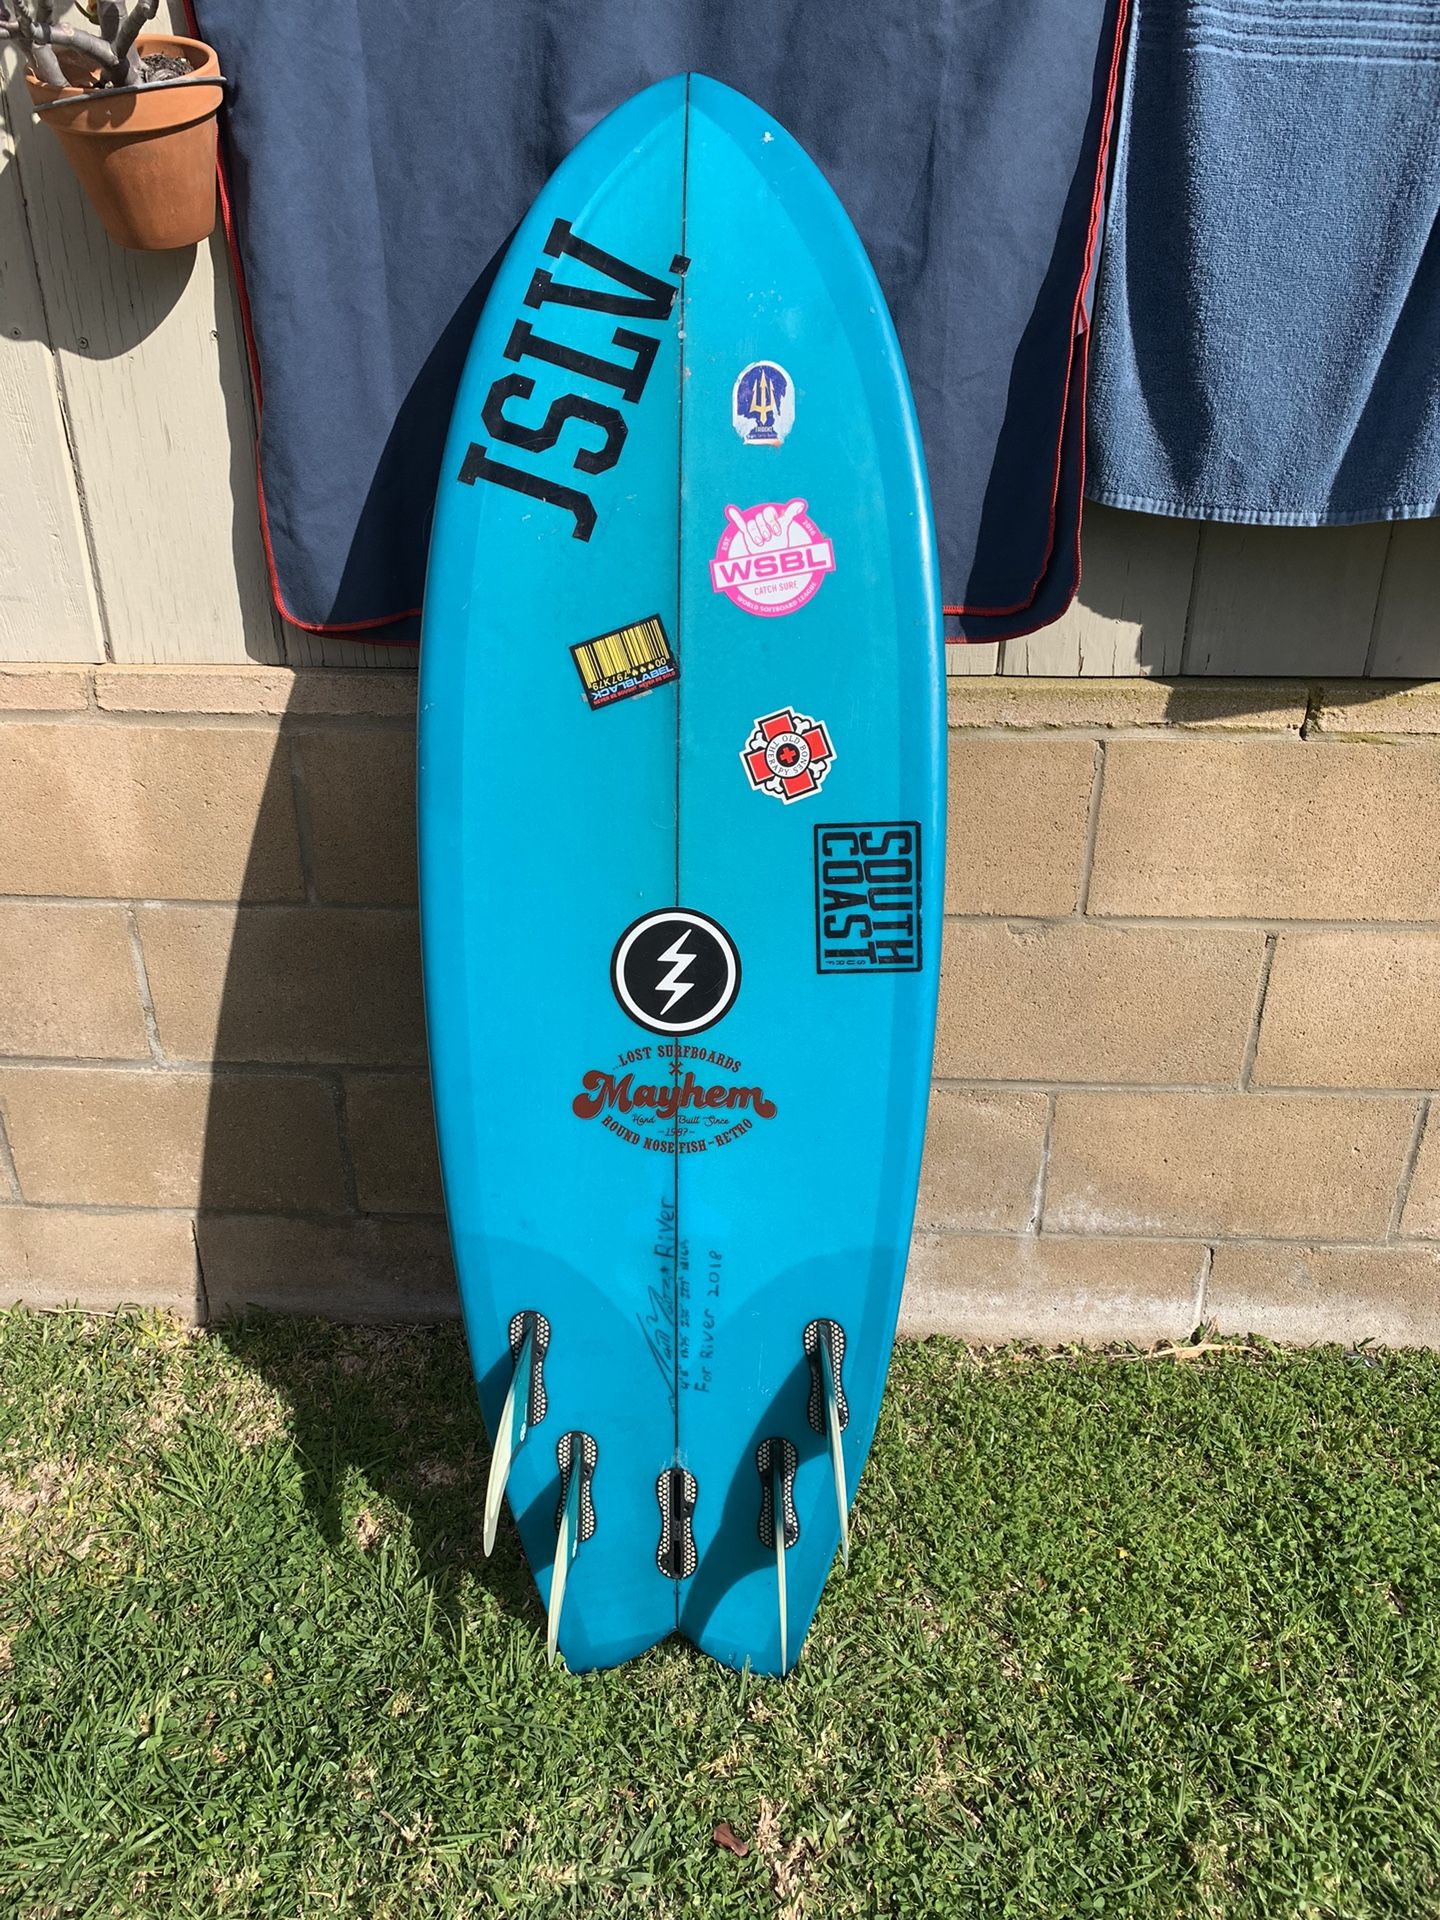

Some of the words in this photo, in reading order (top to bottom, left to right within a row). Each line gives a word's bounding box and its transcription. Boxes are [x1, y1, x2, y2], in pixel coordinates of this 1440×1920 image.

[719, 548, 827, 583] WSBL
[736, 594, 759, 611] WORLD
[759, 600, 798, 613] SOFTBOARD
[797, 582, 817, 603] LEAGUE
[754, 583, 778, 596] CATCH
[592, 679, 634, 700] BLACK
[782, 734, 801, 745] OLD
[768, 741, 790, 776] THERAPY
[822, 831, 878, 965] COAST
[859, 830, 914, 965] SOUTH
[657, 1044, 742, 1073] SURFBOARDS
[572, 1069, 777, 1121] Mayhem
[601, 1114, 641, 1145] ROUND
[643, 1136, 675, 1154] NOSE
[632, 1111, 656, 1126] Hand
[677, 1114, 700, 1125] Built
[702, 1114, 730, 1127] Since
[707, 1250, 723, 1297] 2018
[699, 1307, 716, 1360] River
[694, 1366, 713, 1393] For
